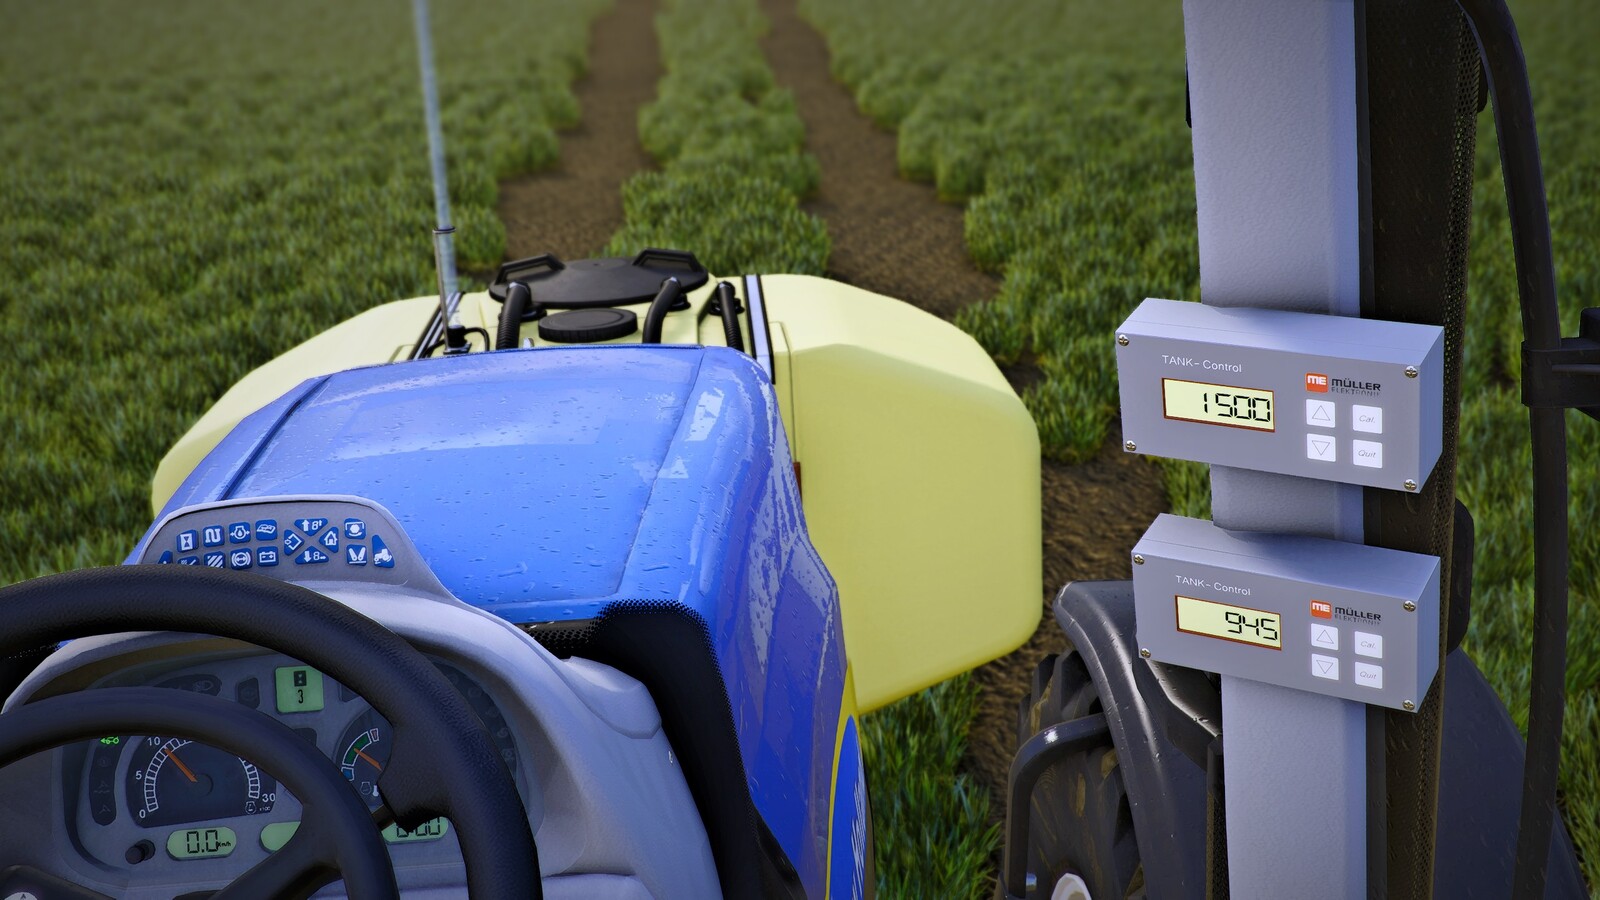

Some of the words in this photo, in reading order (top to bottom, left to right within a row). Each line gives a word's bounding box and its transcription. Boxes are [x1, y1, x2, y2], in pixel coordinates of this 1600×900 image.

[1202, 360, 1242, 373] Control
[1307, 375, 1327, 385] ME
[1332, 378, 1381, 391] MÜLLER
[1203, 391, 1271, 422] 1500
[1358, 450, 1376, 458] Quit
[1214, 582, 1251, 596] Control
[1312, 602, 1330, 612] ME
[1335, 607, 1381, 621] MÜLLER
[1225, 611, 1278, 641] 945
[1360, 671, 1377, 679] Quit
[297, 689, 304, 704] 3
[147, 736, 161, 746] 10
[135, 770, 142, 780] 5
[262, 793, 276, 803] 30
[139, 809, 146, 818] 0
[186, 829, 218, 854] 0.0
